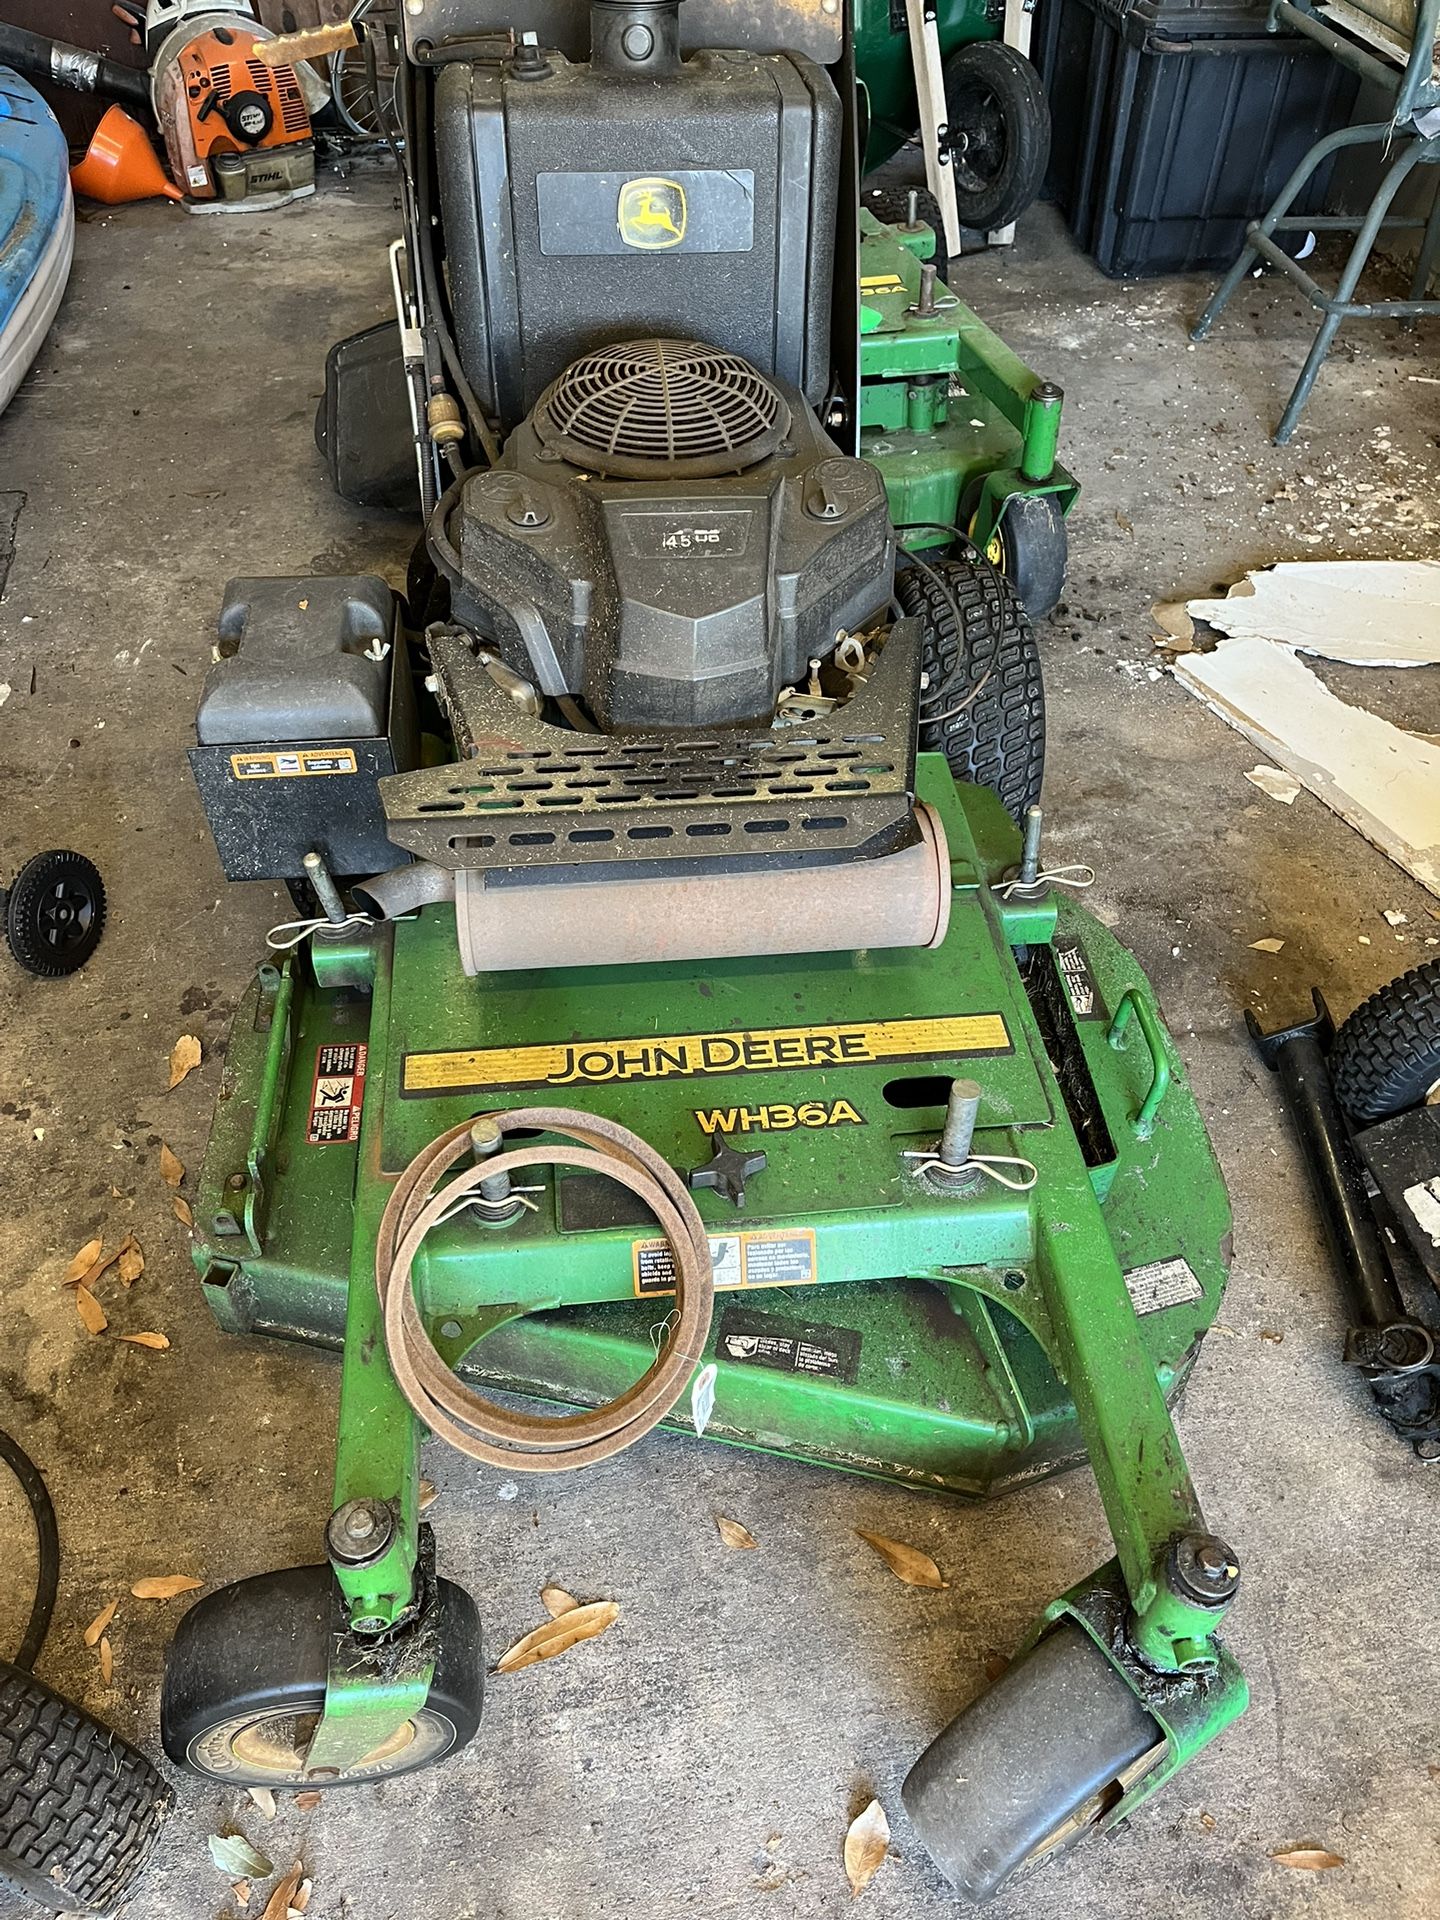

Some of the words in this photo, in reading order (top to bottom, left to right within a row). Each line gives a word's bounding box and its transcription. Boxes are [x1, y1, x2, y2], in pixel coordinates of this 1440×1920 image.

[250, 171, 283, 184] STIHL
[860, 285, 908, 296] 36A
[356, 1051, 367, 1077] DANGER
[545, 1045, 692, 1081] JOHN
[701, 1033, 873, 1071] DEERE
[349, 1112, 361, 1141] PELIGRO
[695, 1100, 862, 1134] WH36A
